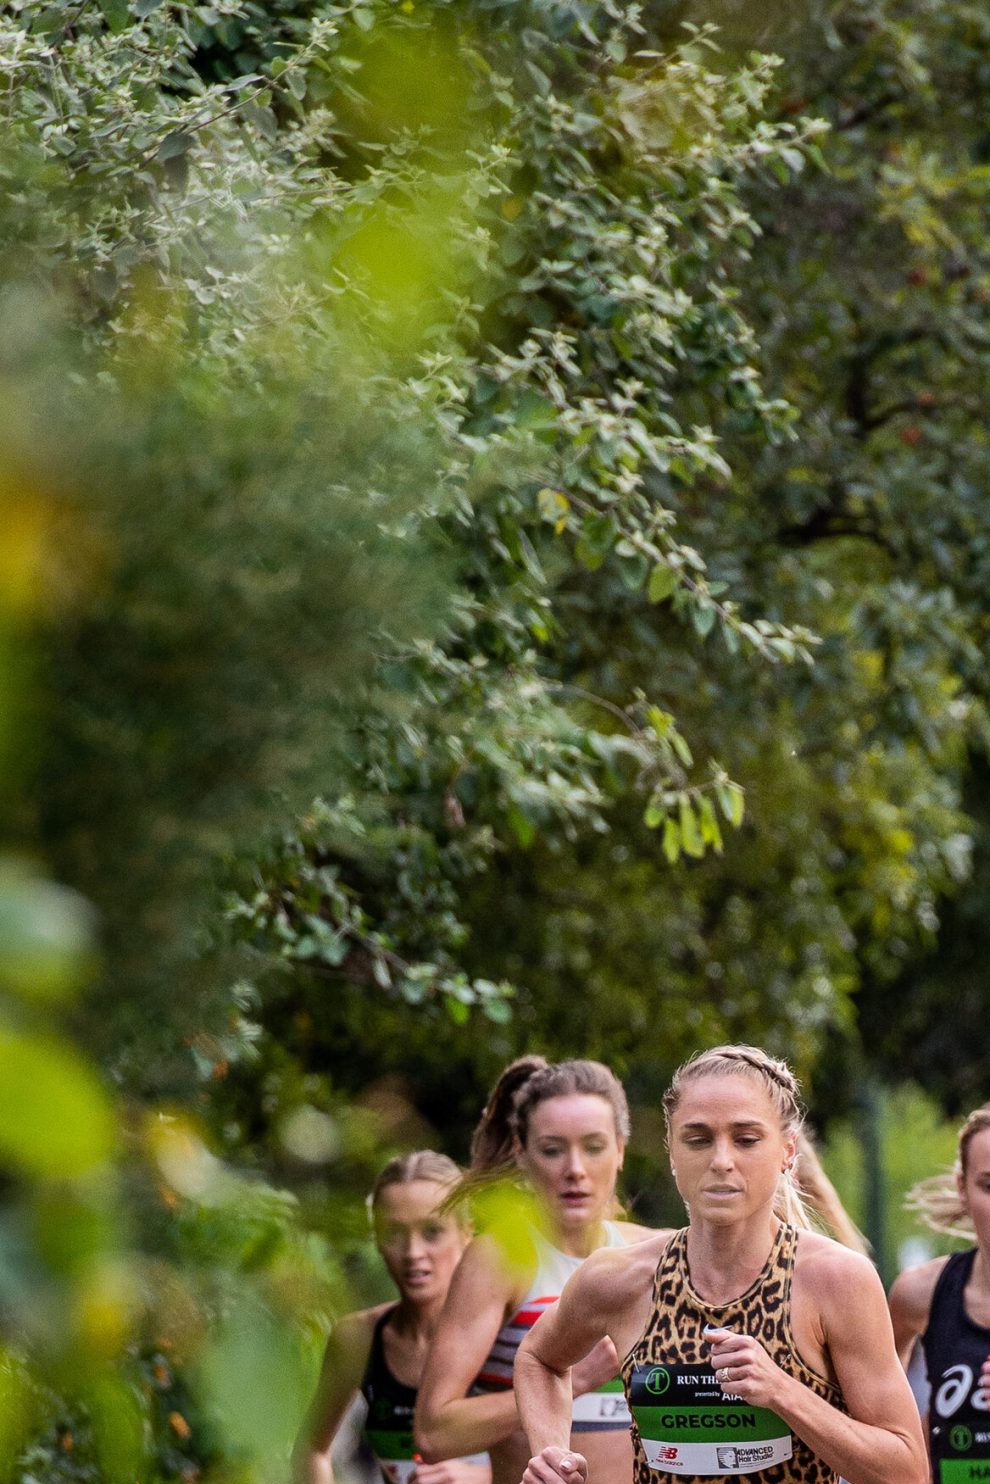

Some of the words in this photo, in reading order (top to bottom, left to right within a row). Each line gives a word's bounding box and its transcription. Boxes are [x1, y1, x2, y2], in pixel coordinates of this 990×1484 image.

[677, 1375, 699, 1385] RUN
[661, 1413, 756, 1429] GREGSON
[736, 1445, 774, 1456] ADVANCED
